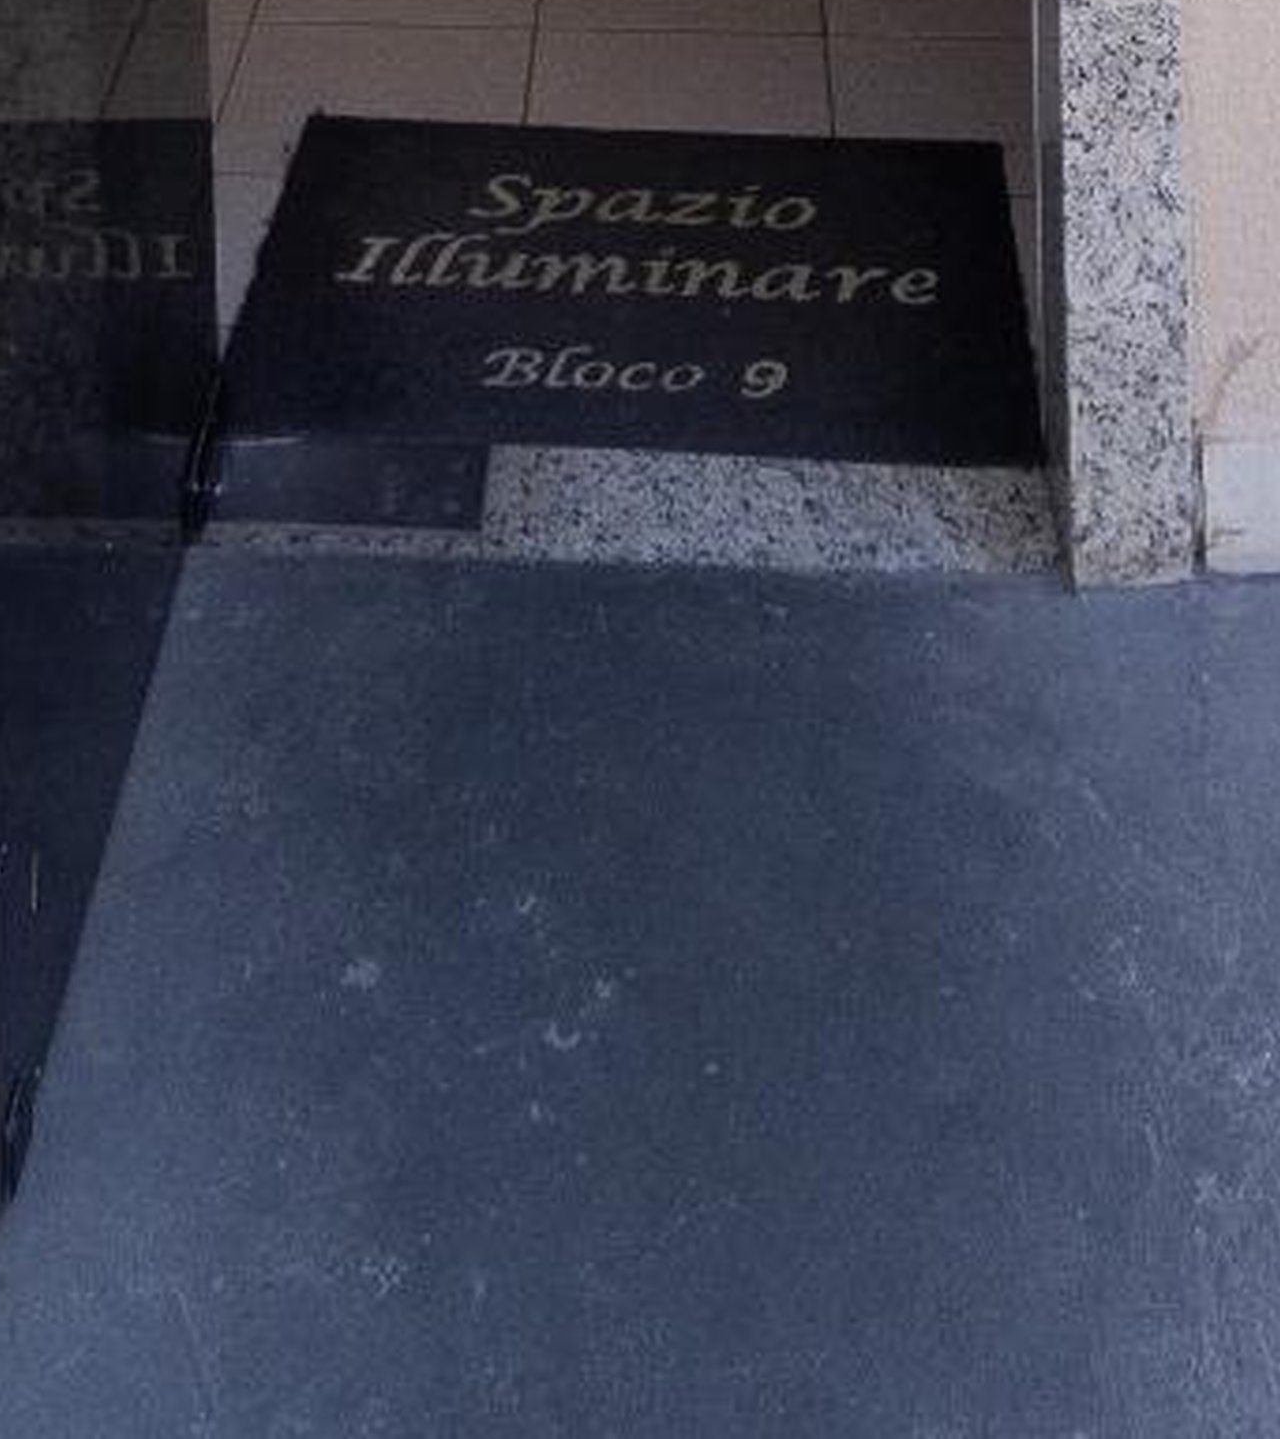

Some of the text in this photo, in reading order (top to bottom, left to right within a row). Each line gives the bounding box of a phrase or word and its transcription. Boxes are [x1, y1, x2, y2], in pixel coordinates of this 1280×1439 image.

[468, 173, 816, 234] Spazio
[333, 233, 938, 304] Illuminare
[482, 344, 788, 399] Bloco 9
